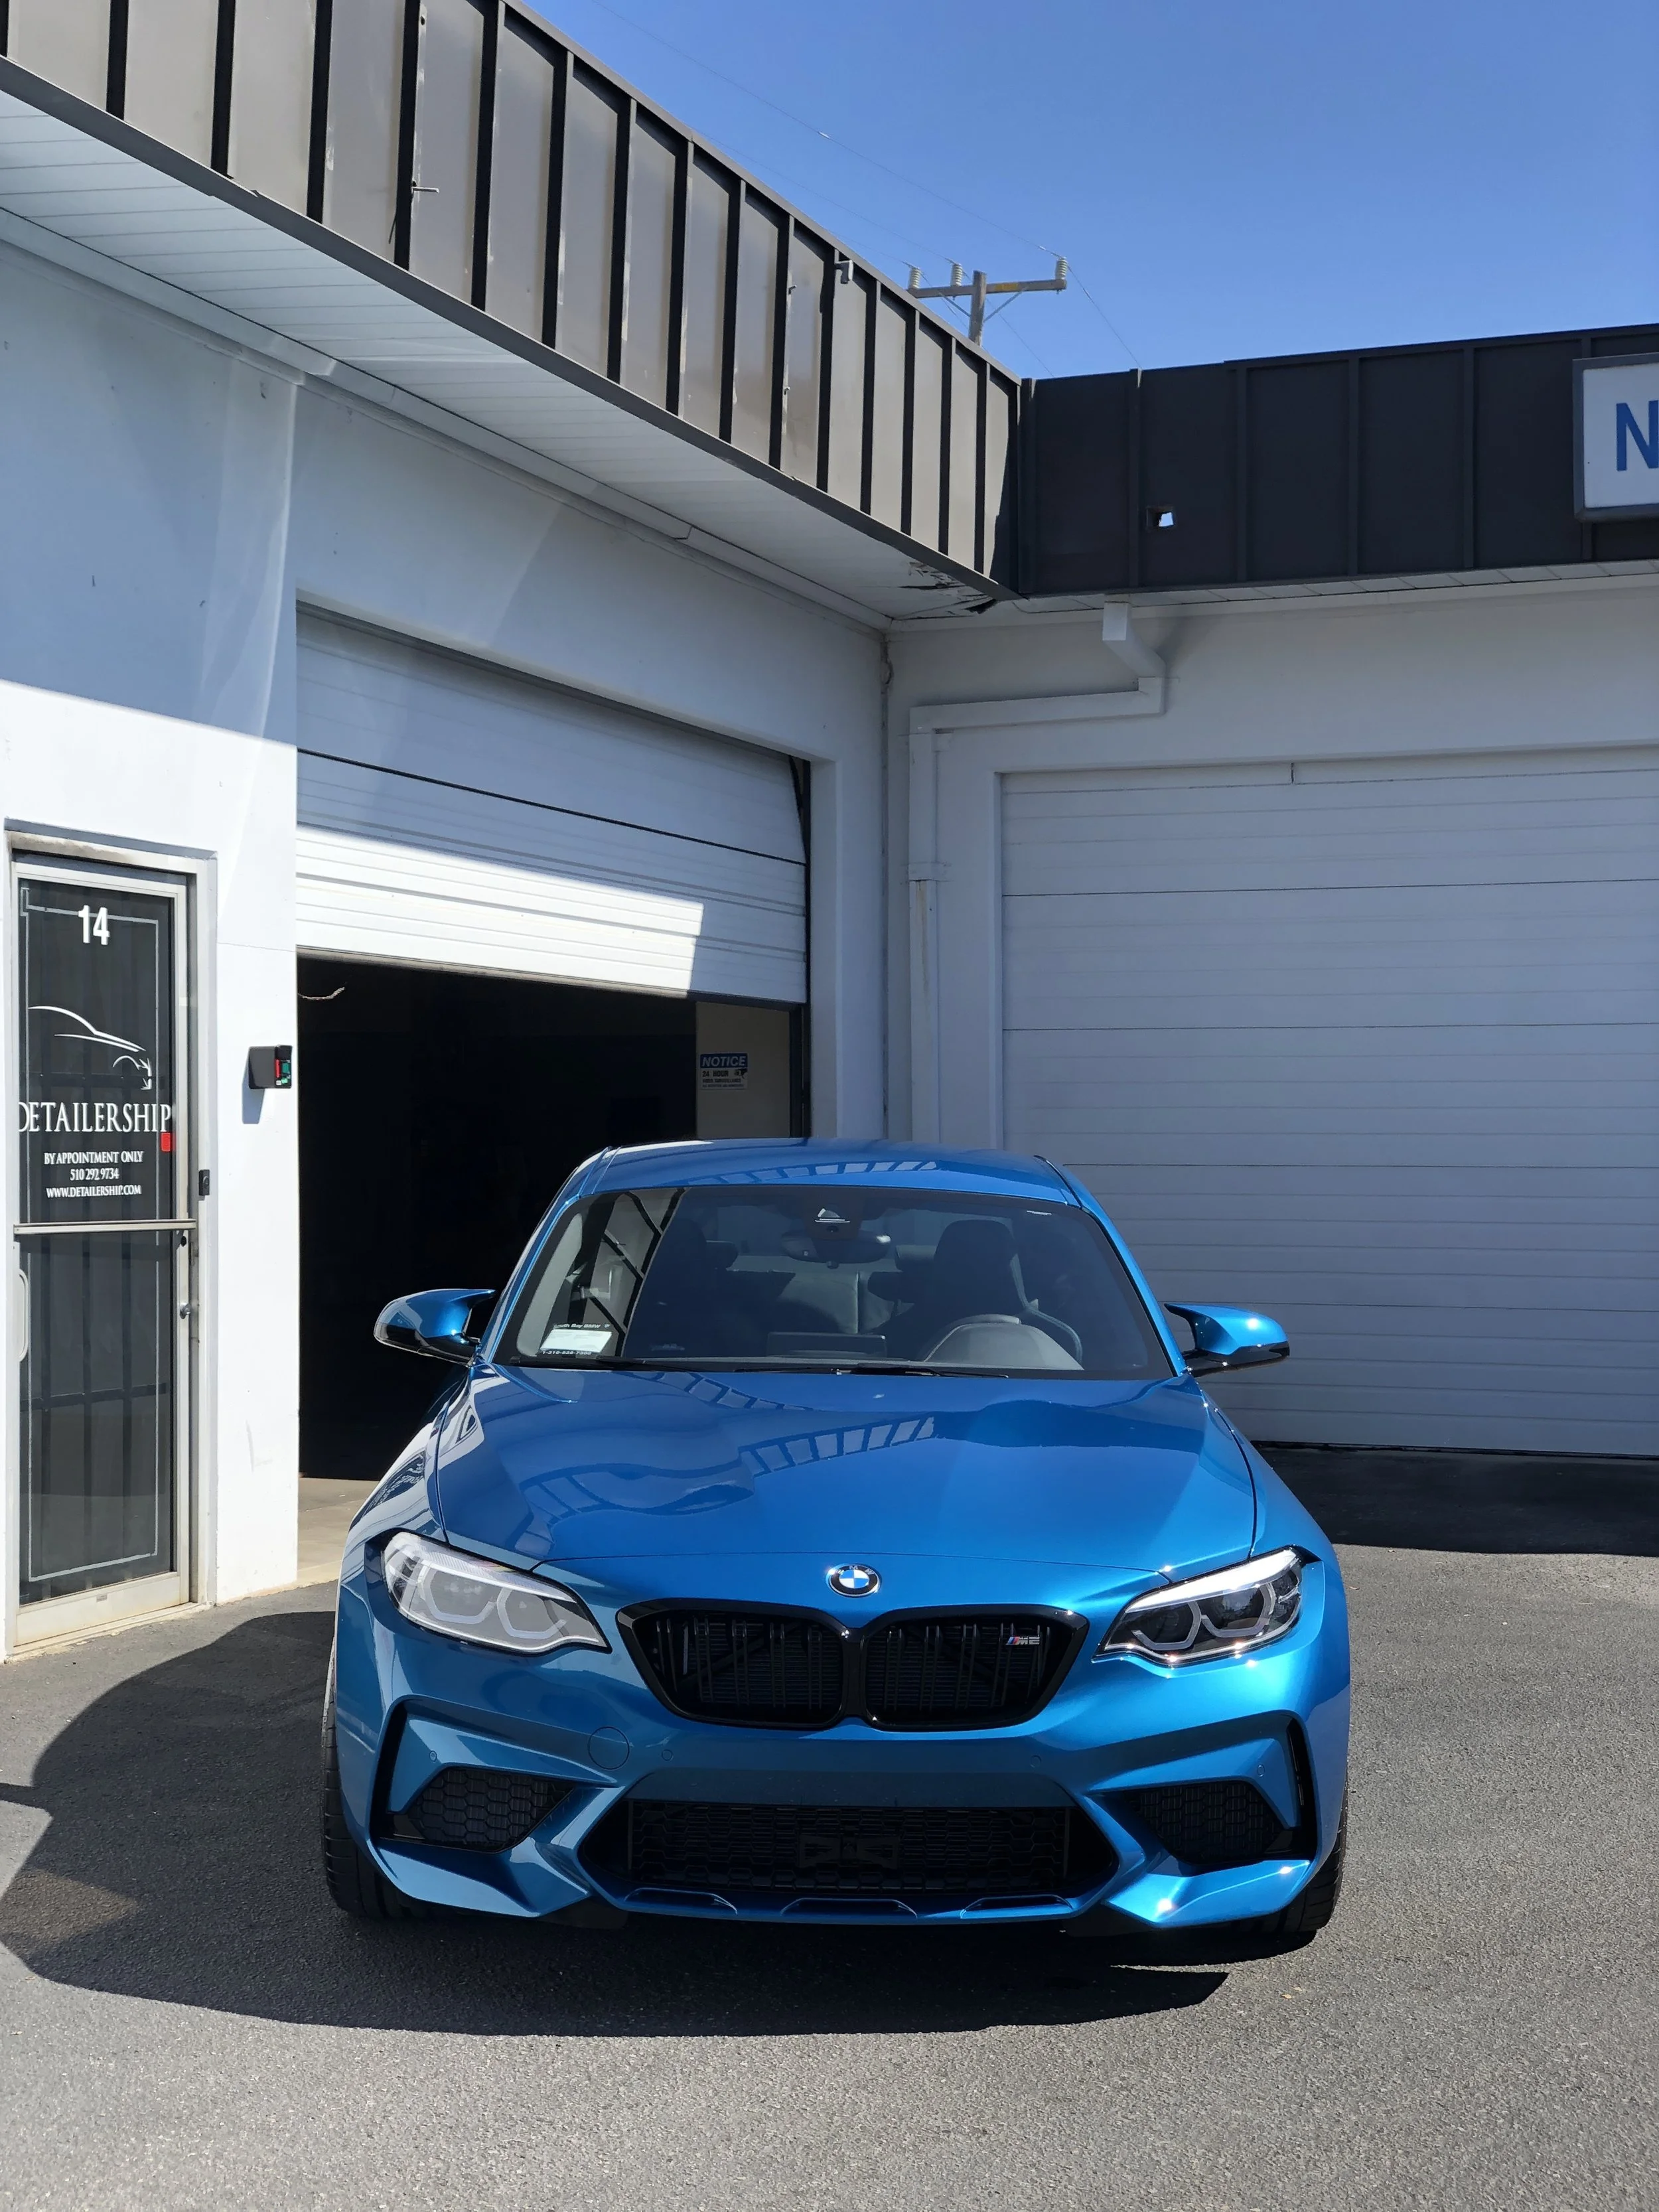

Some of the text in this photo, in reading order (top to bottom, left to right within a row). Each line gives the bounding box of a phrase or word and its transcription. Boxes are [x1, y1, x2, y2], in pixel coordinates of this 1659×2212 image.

[78, 905, 110, 945] 14
[702, 1056, 747, 1067] NOTICE
[19, 1102, 171, 1132] DETAILERSHIP
[44, 1151, 144, 1165] BY APPOINTMENT ONLY
[70, 1167, 119, 1181] 510 292 9734
[46, 1185, 142, 1198] WWW.DETAILERSHIP.COM
[1016, 1636, 1041, 1645] M2
